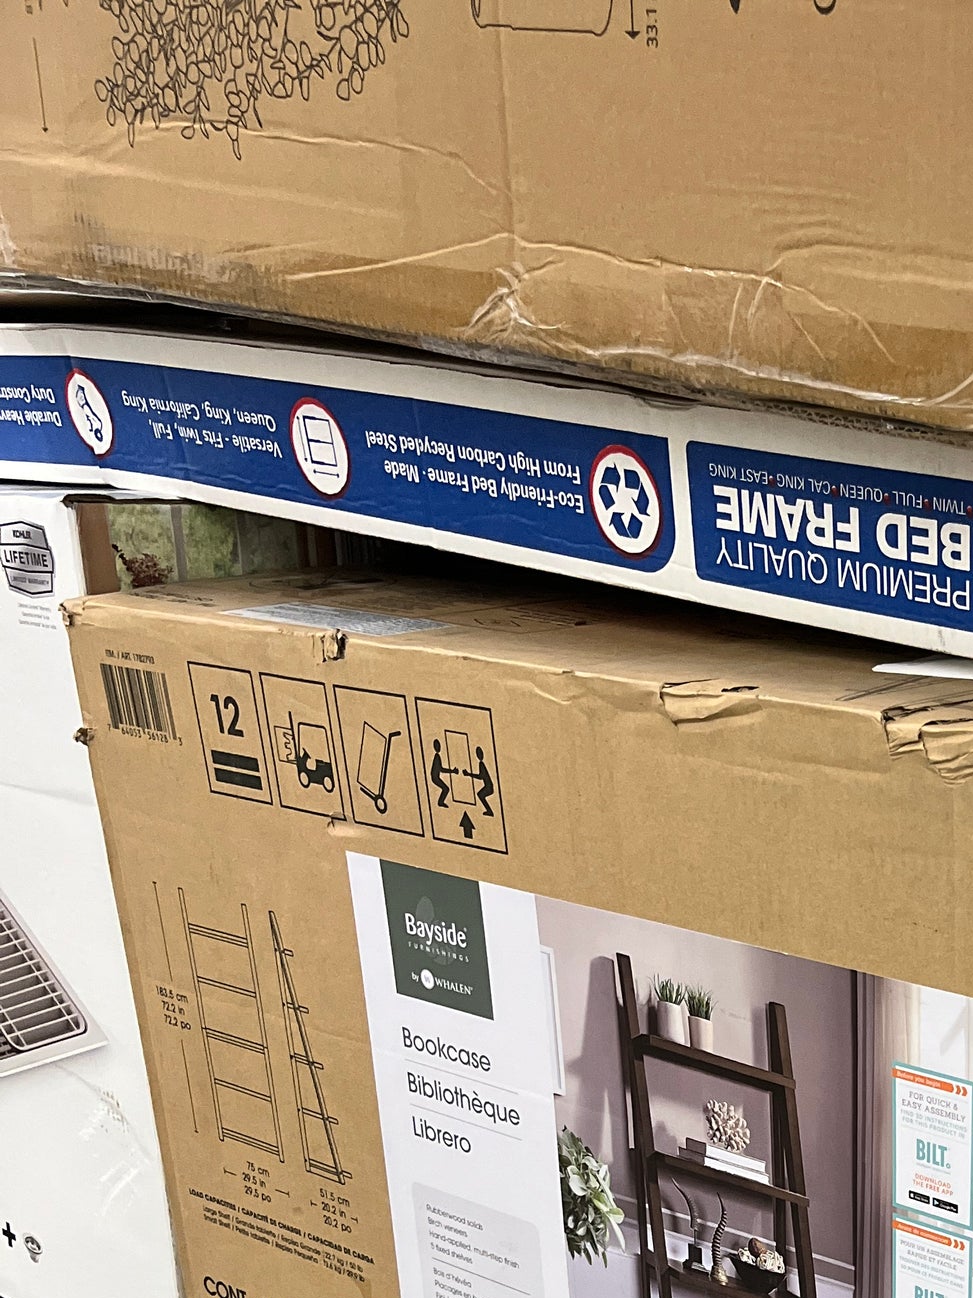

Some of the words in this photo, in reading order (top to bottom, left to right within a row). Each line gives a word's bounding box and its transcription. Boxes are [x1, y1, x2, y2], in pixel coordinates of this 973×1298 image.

[31, 384, 56, 404] Duty
[121, 391, 148, 413] King
[0, 409, 25, 426] Heav
[24, 410, 62, 427] Durable
[150, 395, 200, 421] California
[201, 402, 231, 426] King,
[148, 420, 173, 441] Full,
[233, 409, 277, 432] Queen,
[175, 422, 202, 445] Twin,
[203, 431, 223, 449] Fits
[365, 430, 397, 452] Steel
[233, 437, 283, 458] Versatile
[400, 437, 455, 462] Recycled
[457, 444, 506, 471] Carbon
[384, 459, 420, 483] Made
[508, 451, 541, 478] High
[542, 463, 581, 485] From
[708, 463, 737, 480] KING
[428, 468, 469, 493] Frame
[472, 474, 497, 496] Bed
[740, 467, 769, 485] EAST
[776, 473, 805, 490] KING
[808, 478, 832, 495] CAL
[502, 477, 584, 514] Eco-Friendly
[840, 484, 885, 503] QUEEN
[893, 490, 926, 509] FULL
[933, 496, 967, 516] TWIN
[713, 484, 861, 553] FRAME
[876, 512, 971, 572] BED
[4, 548, 49, 568] LIFETIME
[716, 537, 828, 585] QUALITY
[837, 557, 970, 611] PREMIUM
[210, 694, 245, 738] 12
[404, 912, 467, 949] Bayside
[408, 941, 471, 963] FURNISHINGS
[411, 971, 419, 983] by
[155, 985, 176, 1002] 183.5
[175, 993, 189, 1004] cm
[161, 1000, 178, 1015] 72.2
[178, 1004, 186, 1016] in
[163, 1013, 180, 1028] 72.2
[180, 1020, 192, 1033] po
[402, 1026, 491, 1072] Bookcase
[407, 1071, 521, 1126] Bibliothèque
[411, 1115, 472, 1154] Librero
[242, 1172, 258, 1186] 29.5
[258, 1177, 267, 1189] in
[246, 1161, 256, 1174] 75
[257, 1167, 271, 1179] cm
[244, 1185, 260, 1199] 29.5
[261, 1192, 272, 1203] po
[319, 1188, 336, 1203] 51.5
[337, 1197, 350, 1208] cm
[321, 1201, 338, 1216] 20.2
[339, 1206, 347, 1219] in
[323, 1214, 339, 1229] 20.2
[340, 1222, 352, 1234] po
